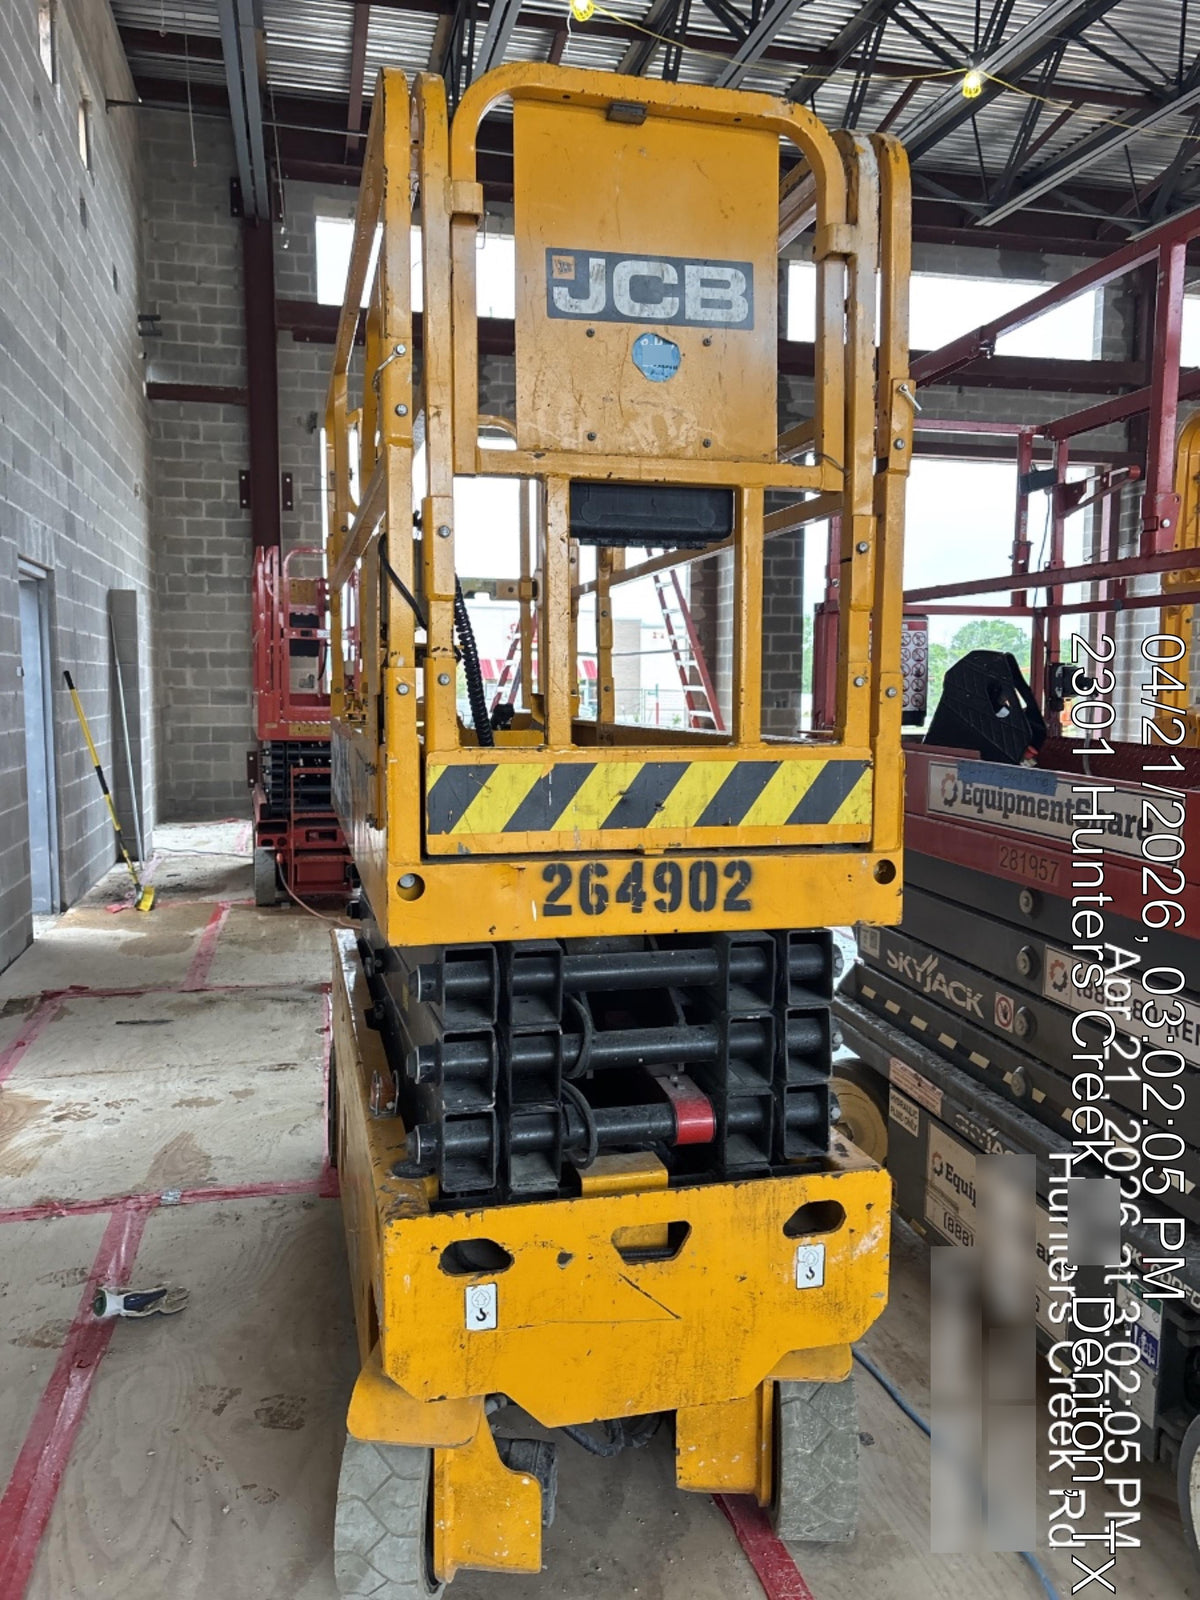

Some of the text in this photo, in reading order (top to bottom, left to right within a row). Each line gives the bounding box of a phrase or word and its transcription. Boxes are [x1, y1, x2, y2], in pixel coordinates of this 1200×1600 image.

[553, 257, 749, 322] JCB
[542, 860, 752, 916] 264902
[999, 846, 1060, 884] 281957
